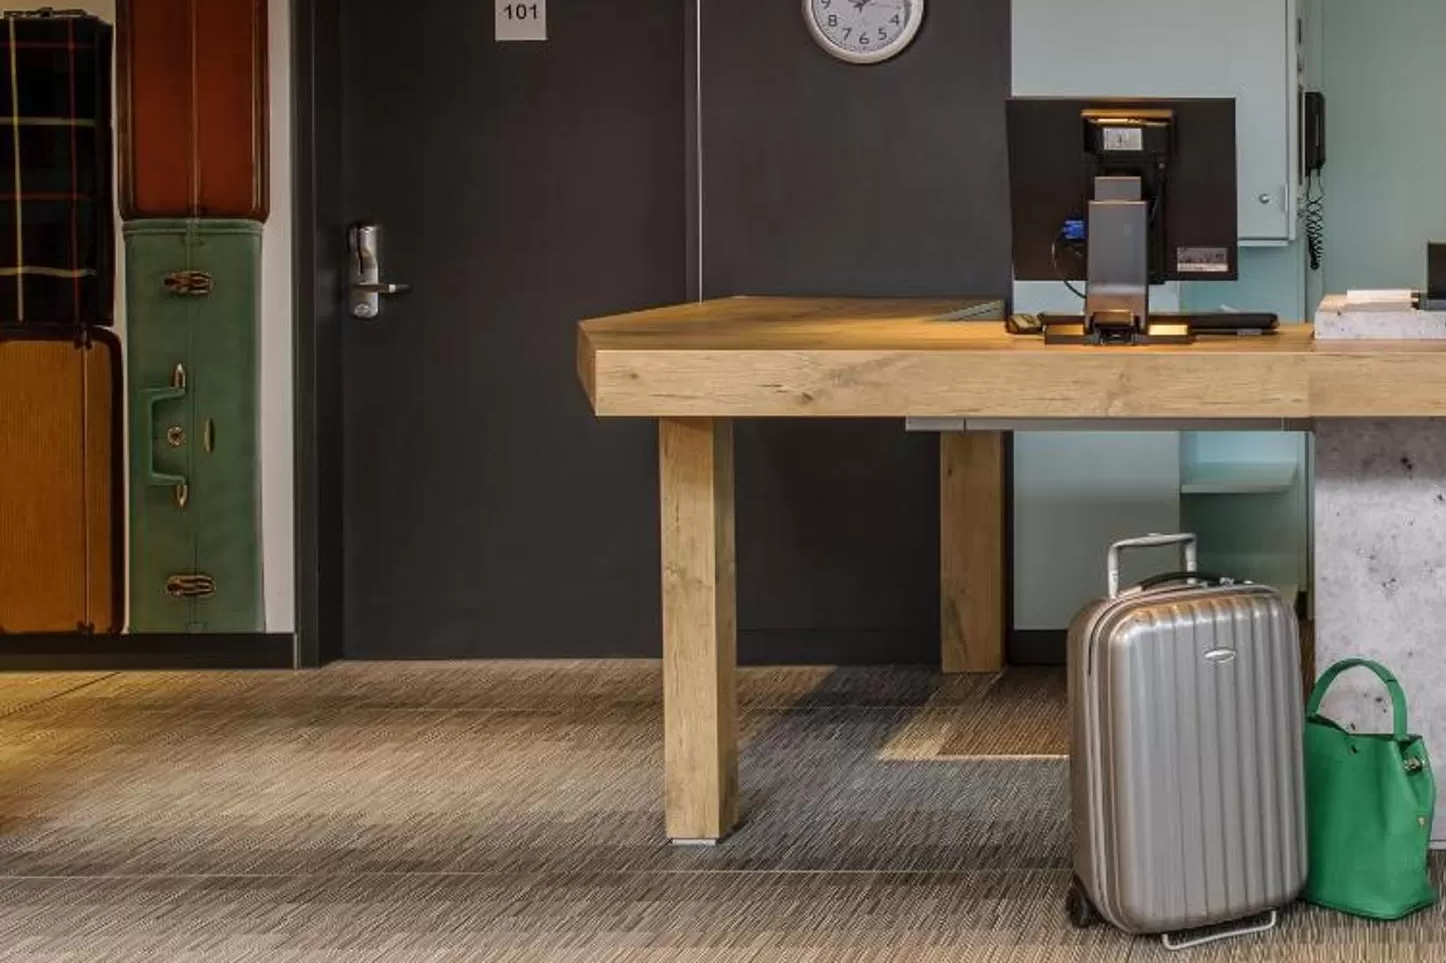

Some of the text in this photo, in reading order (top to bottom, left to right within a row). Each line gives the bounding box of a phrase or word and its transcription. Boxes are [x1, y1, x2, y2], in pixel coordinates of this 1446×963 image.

[503, 4, 538, 21] 101
[828, 15, 838, 27] 8
[842, 28, 853, 41] 7
[859, 32, 869, 44] 6
[878, 28, 888, 40] 5
